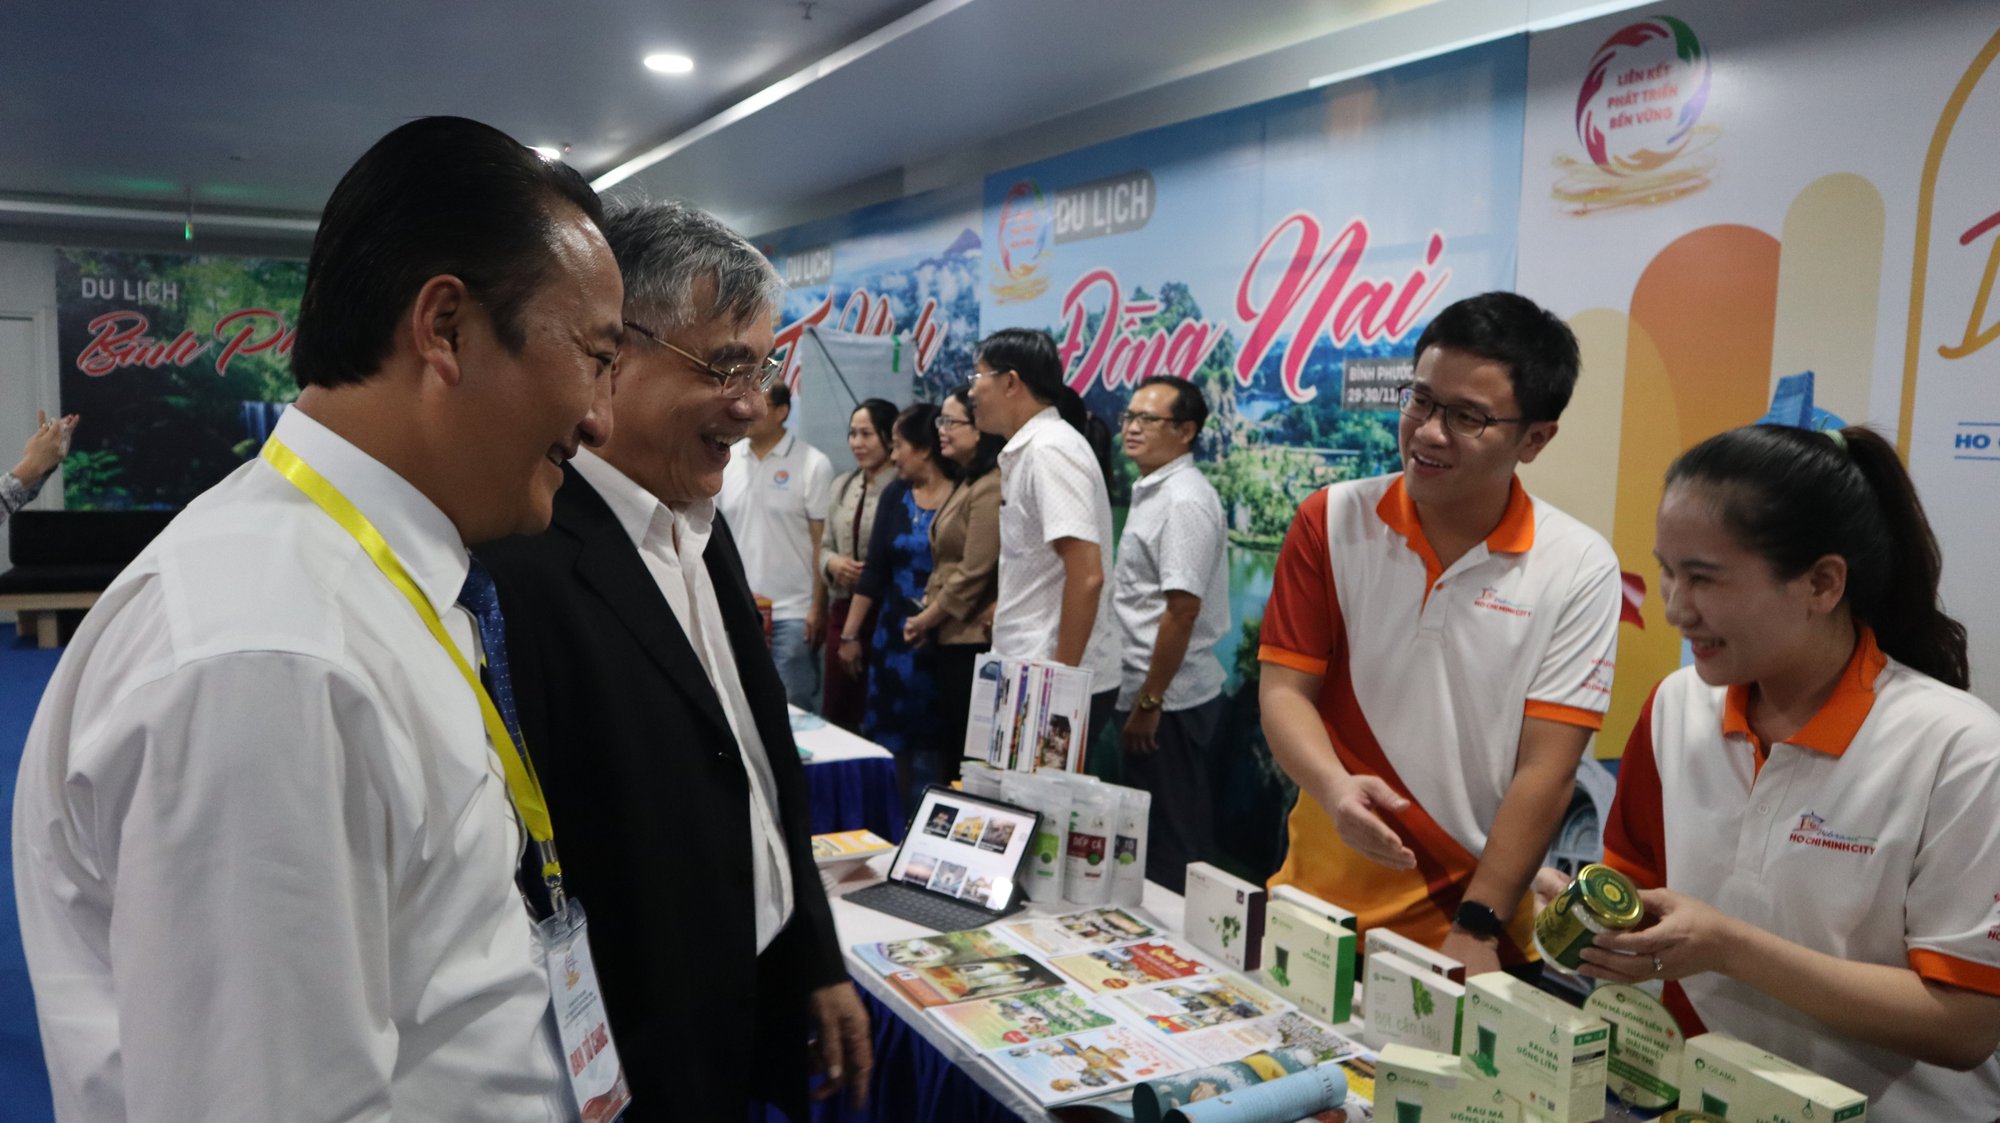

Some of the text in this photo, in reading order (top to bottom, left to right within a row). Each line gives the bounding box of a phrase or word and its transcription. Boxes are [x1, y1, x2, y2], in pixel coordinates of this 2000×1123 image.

[1617, 66, 1644, 87] LIÊN
[1093, 179, 1148, 235] LỊCH
[81, 278, 179, 306] DU LỊCH
[1058, 209, 1452, 404] Đồng Nai
[1349, 363, 1376, 382] BÌNH
[1955, 433, 1992, 450] HO
[1789, 832, 1877, 856] HO CHI MINH CITY
[1529, 1041, 1545, 1054] RAU
[1466, 1105, 1486, 1116] RAU
